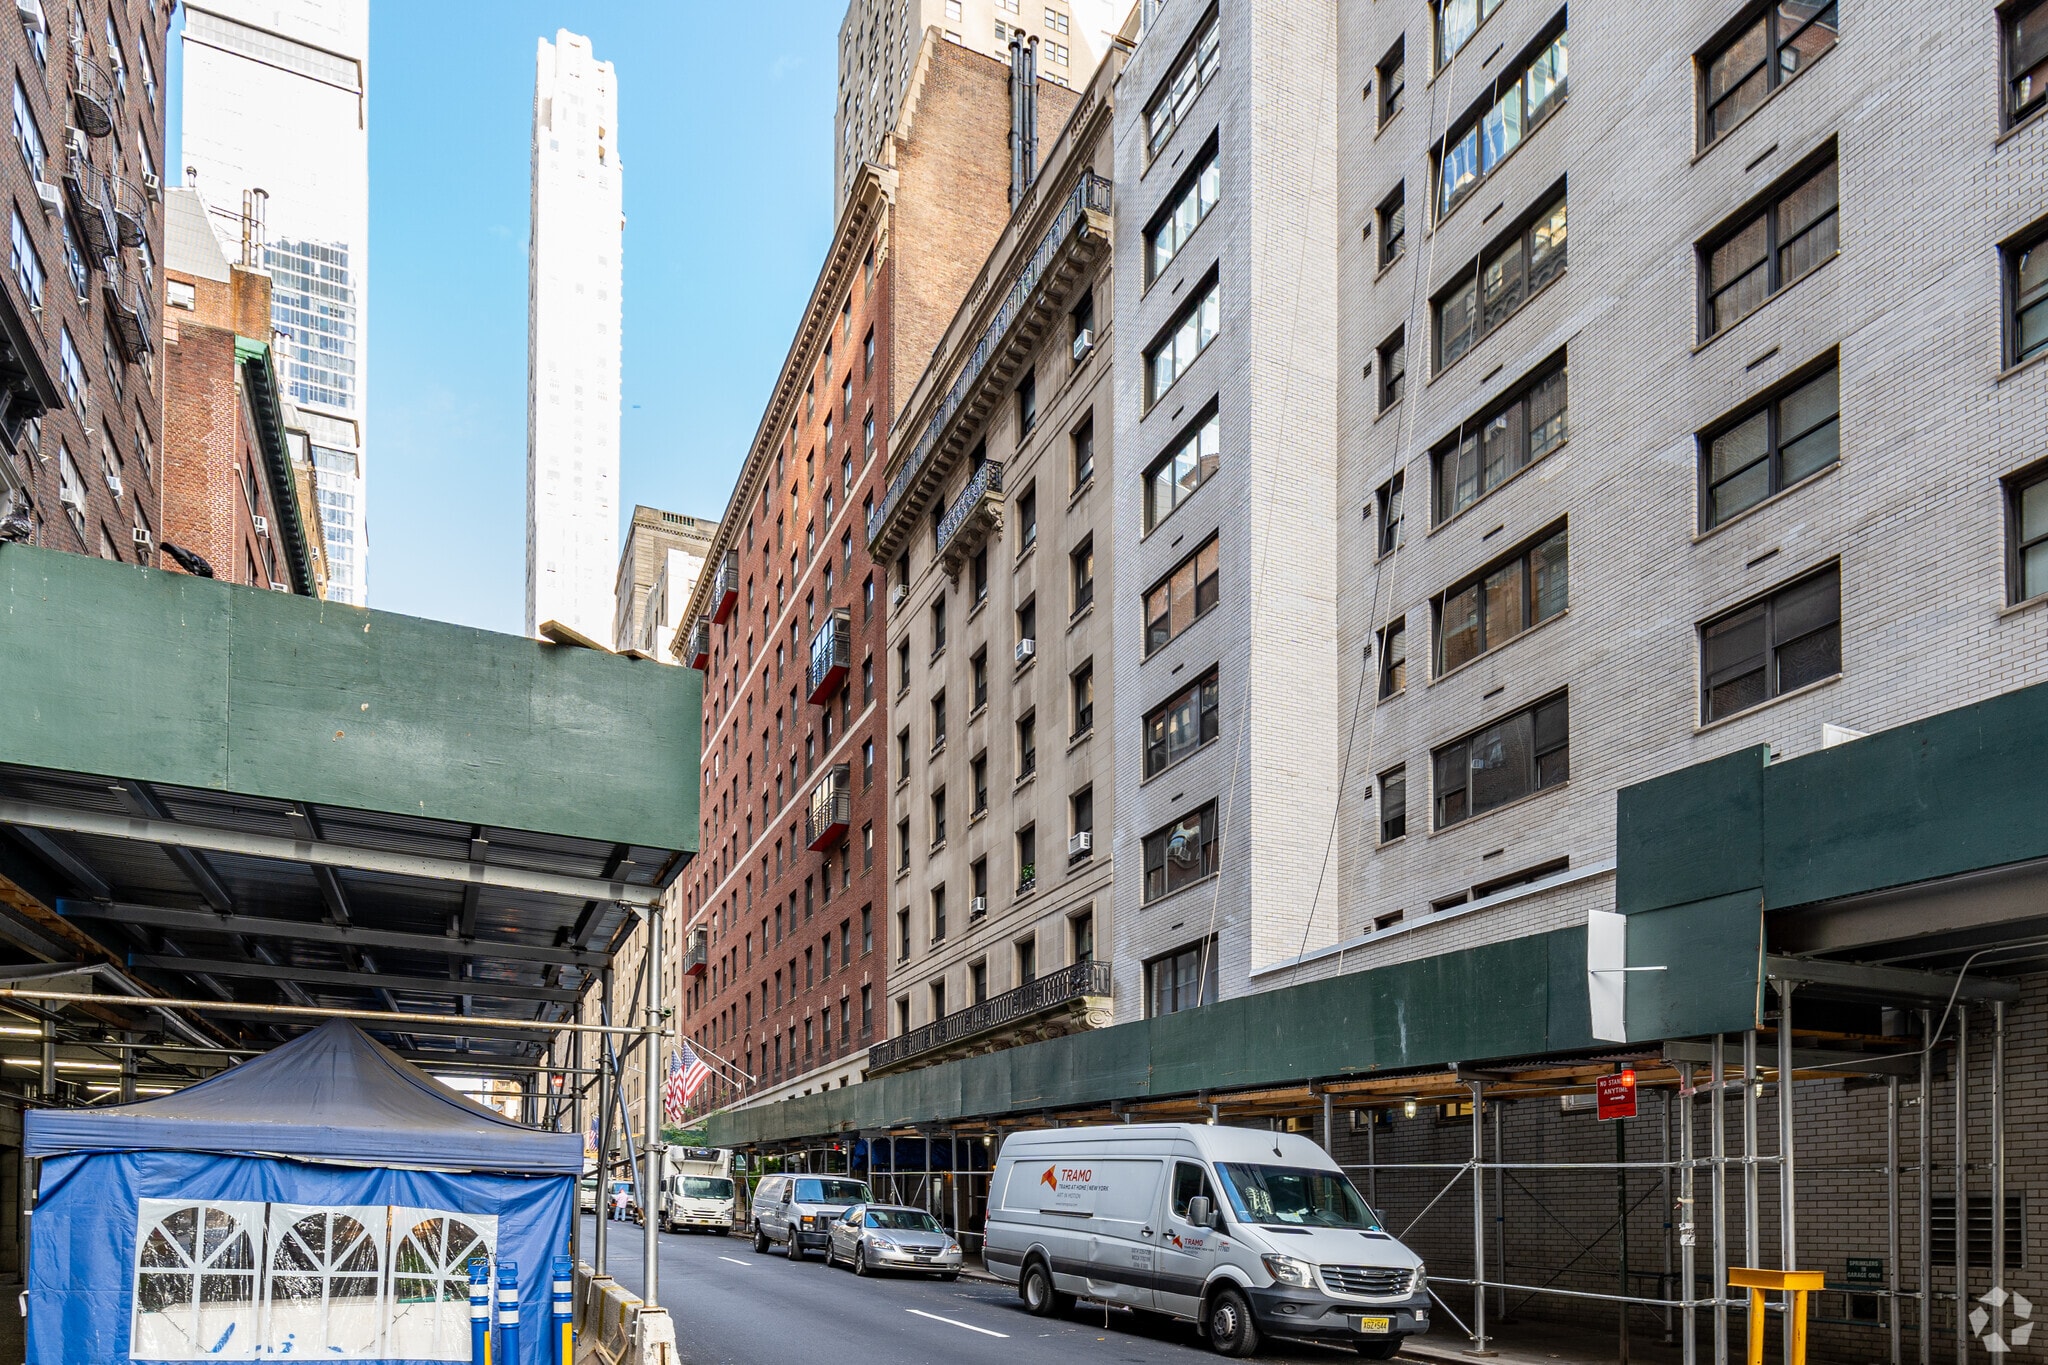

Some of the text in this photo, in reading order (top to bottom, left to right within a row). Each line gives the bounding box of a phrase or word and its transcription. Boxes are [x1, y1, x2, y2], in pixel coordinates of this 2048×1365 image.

[1603, 1087, 1629, 1095] ANYTIME
[1061, 1169, 1092, 1182] TRAMO
[1184, 1237, 1204, 1247] TRAMO
